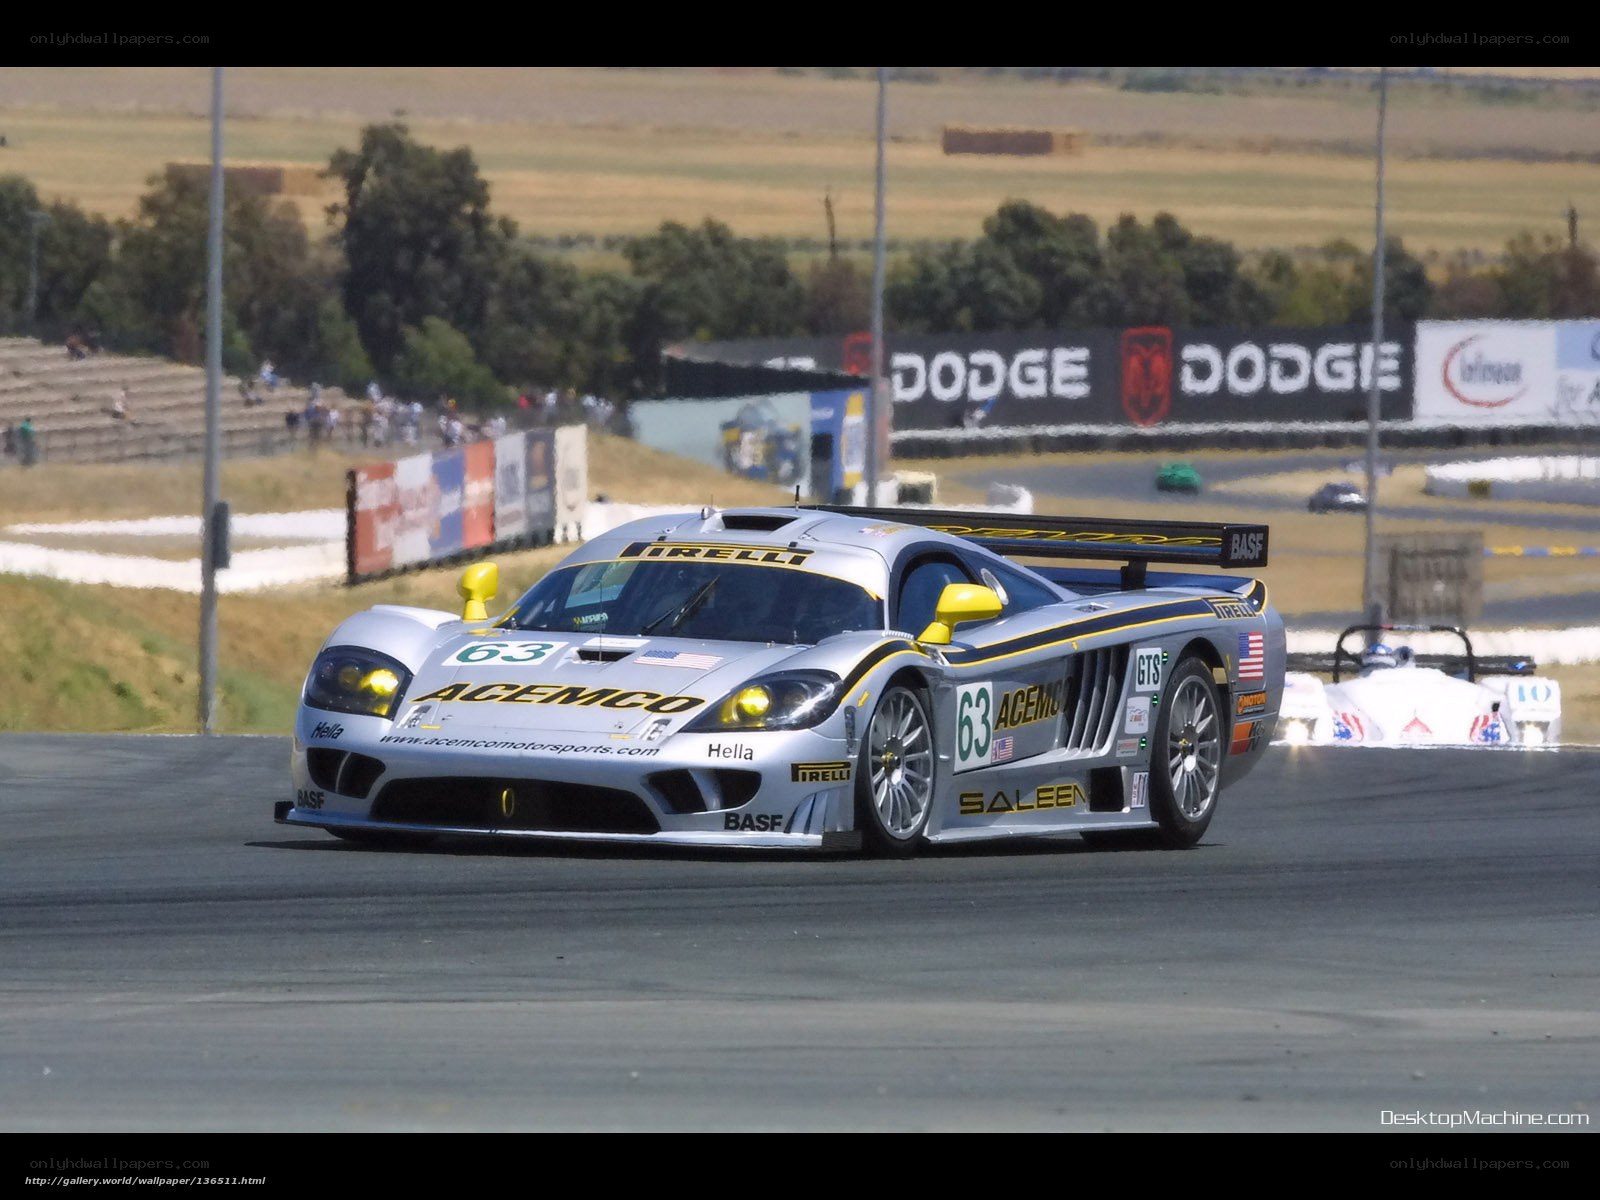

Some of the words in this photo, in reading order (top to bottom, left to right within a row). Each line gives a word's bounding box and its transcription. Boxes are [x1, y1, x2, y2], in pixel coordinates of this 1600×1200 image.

[890, 346, 1090, 402] DODGE
[1179, 340, 1403, 396] DODGE
[618, 541, 815, 567] PIRELLI
[1230, 532, 1263, 561] BASF
[1204, 597, 1257, 620] PIRELLI
[455, 642, 554, 663] 63
[1136, 654, 1161, 685] GTS
[408, 680, 706, 714] ACEMCO
[311, 721, 345, 740] Hella
[957, 687, 992, 763] 63
[379, 734, 661, 758] www.acemcomotorsports.com
[707, 743, 754, 761] Hella
[790, 761, 852, 783] PIRELLI
[296, 788, 325, 809] BASF
[724, 811, 783, 832] BASF
